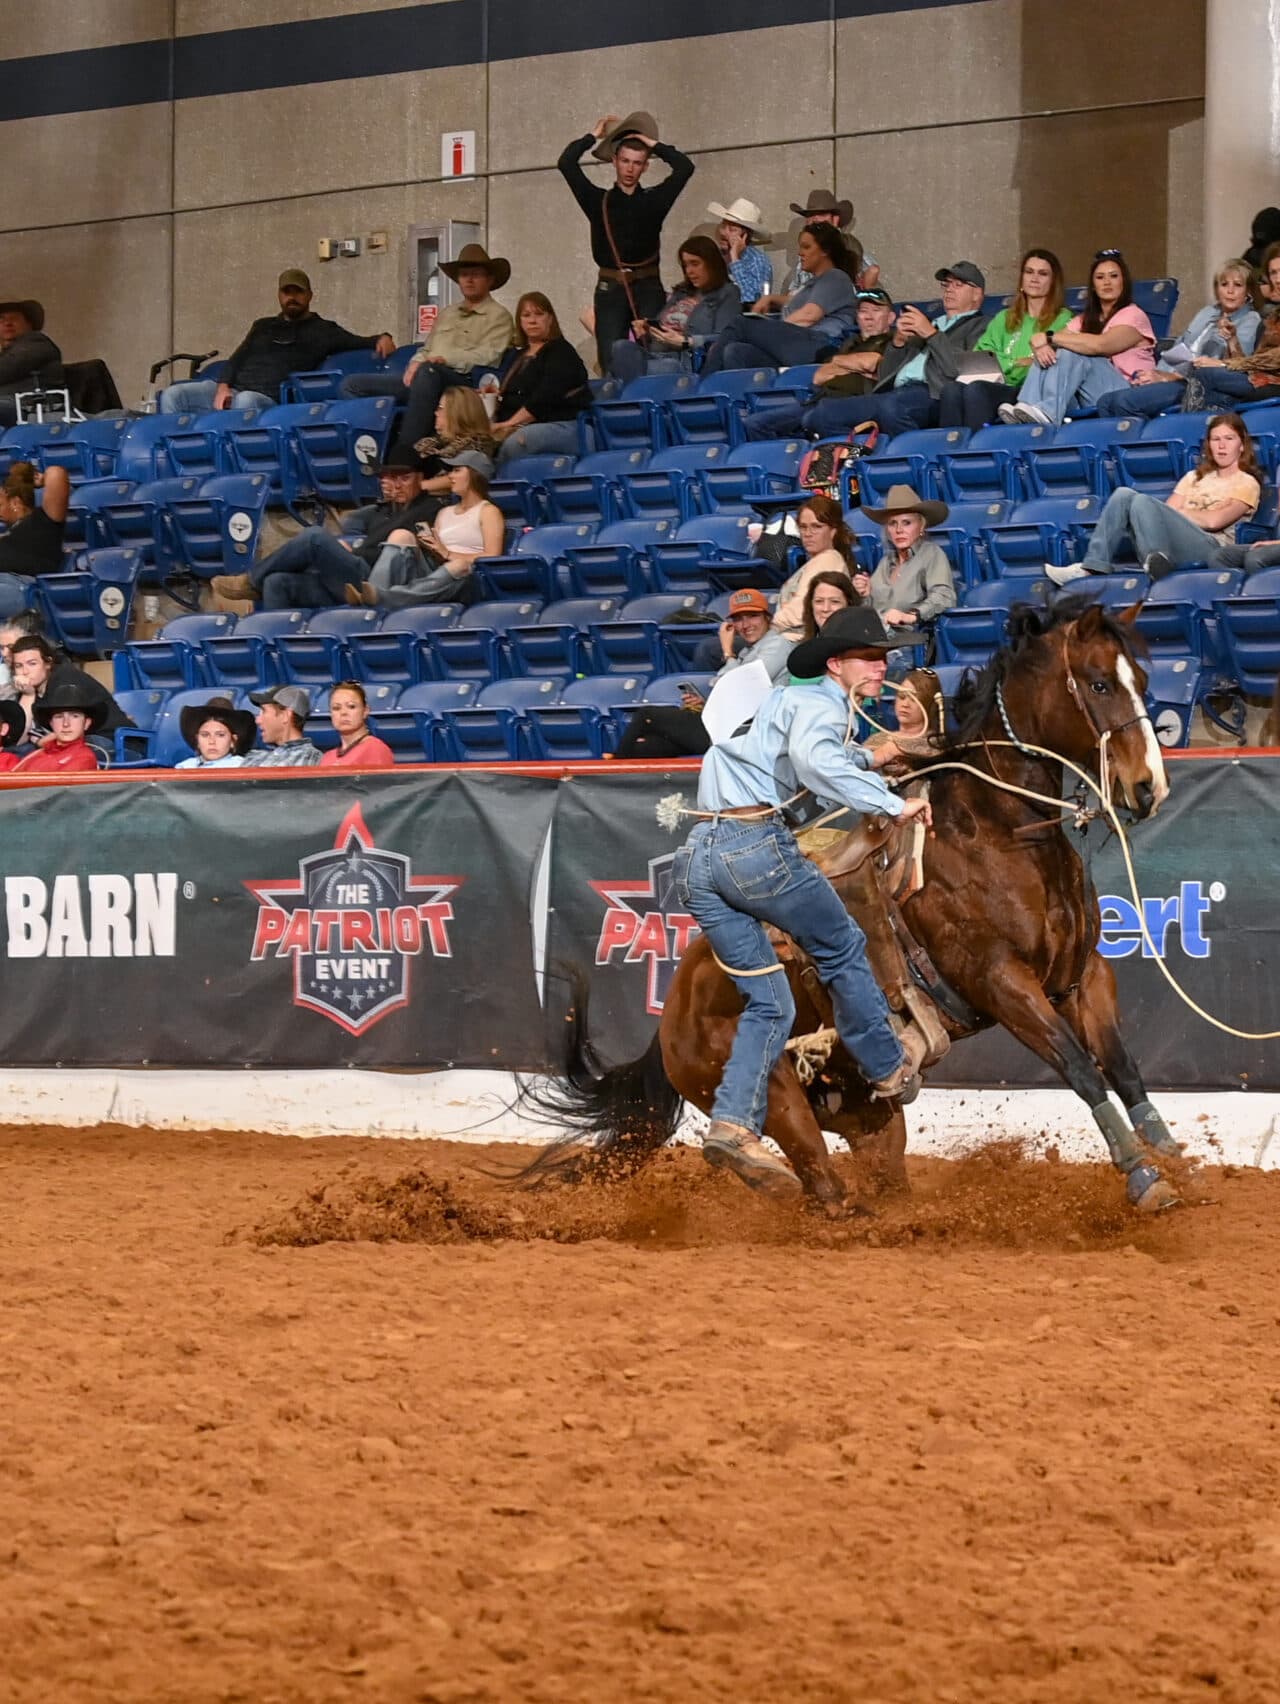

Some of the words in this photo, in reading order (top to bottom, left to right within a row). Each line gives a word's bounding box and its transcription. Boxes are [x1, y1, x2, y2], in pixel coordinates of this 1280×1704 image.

[335, 883, 371, 905] THE
[250, 901, 456, 961] PATRIOT
[315, 957, 392, 980] EVENT
